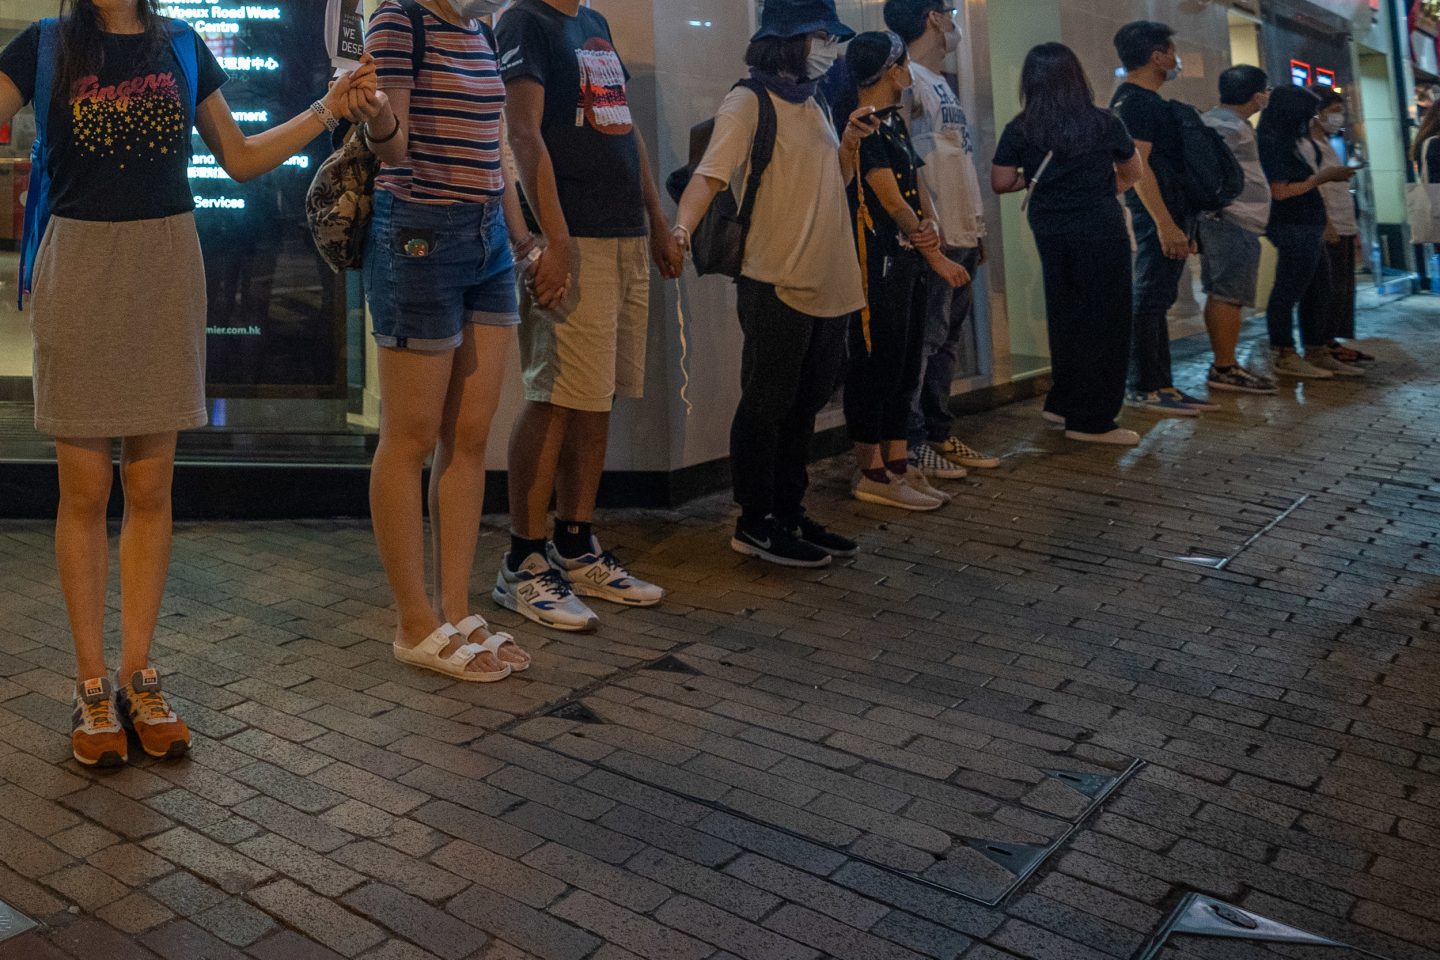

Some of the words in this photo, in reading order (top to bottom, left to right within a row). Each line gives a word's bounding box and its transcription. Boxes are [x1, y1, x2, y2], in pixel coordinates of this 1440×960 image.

[343, 26, 356, 39] WE
[341, 40, 364, 56] DESE
[193, 195, 245, 209] Services
[206, 325, 262, 336] mier.com.hk
